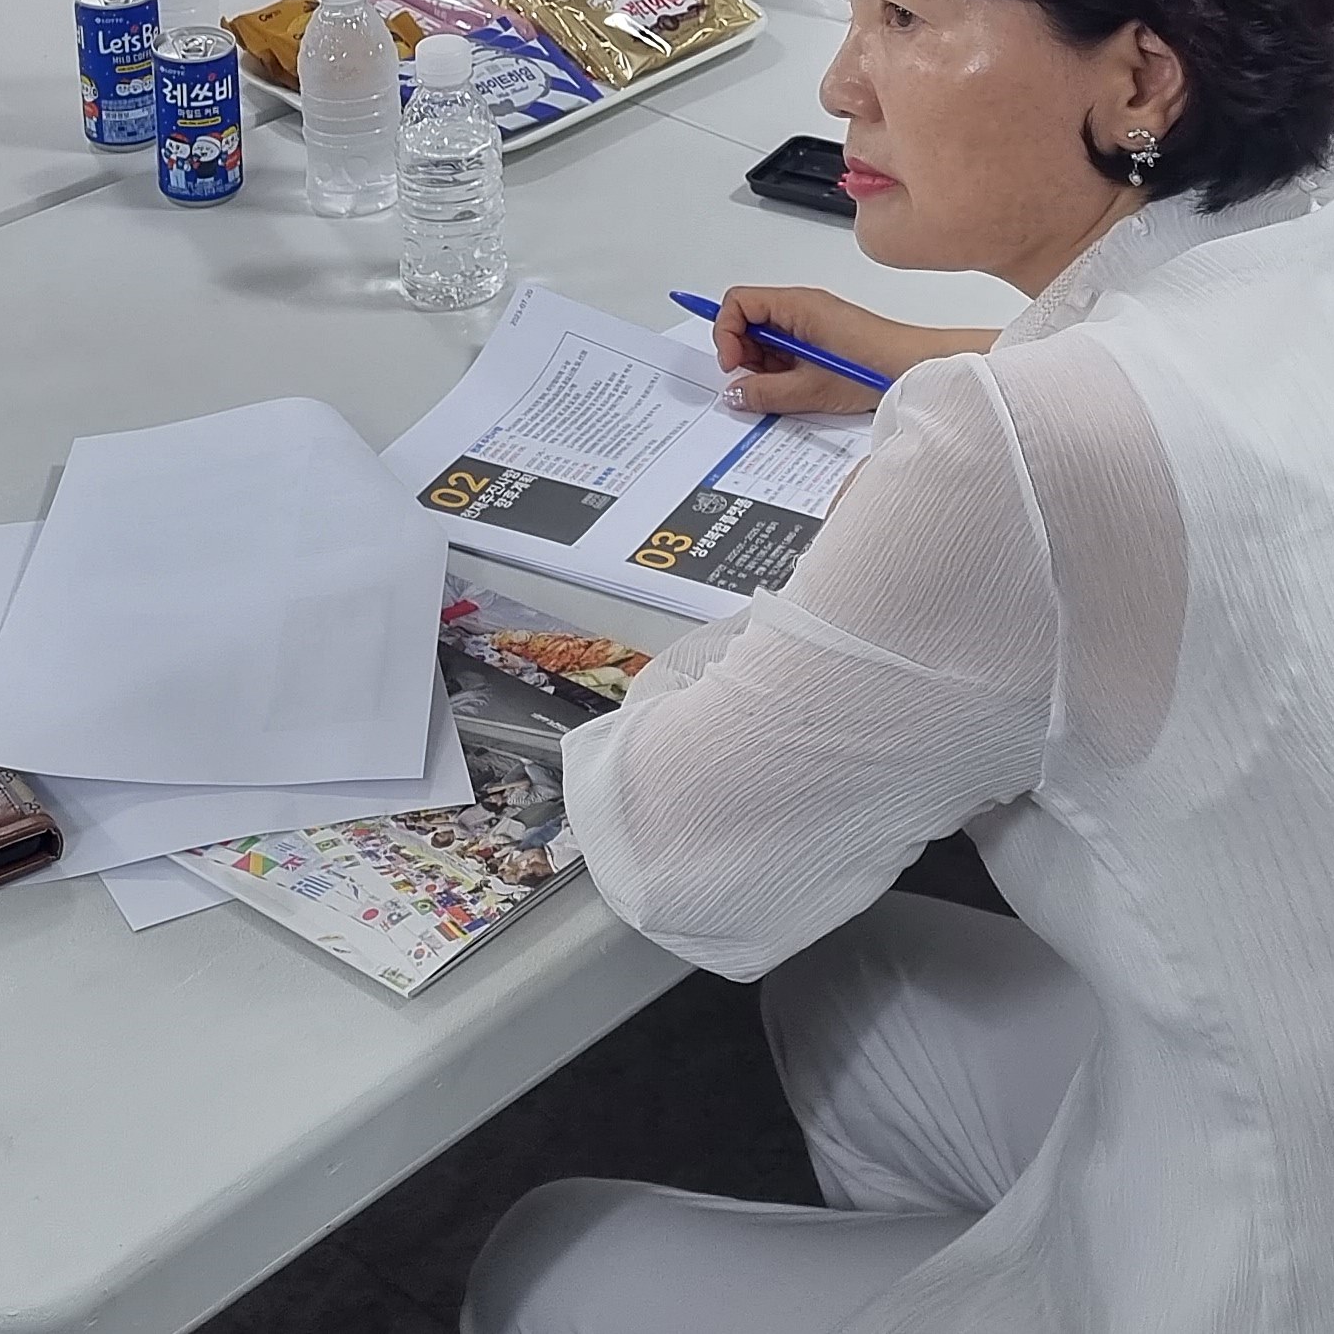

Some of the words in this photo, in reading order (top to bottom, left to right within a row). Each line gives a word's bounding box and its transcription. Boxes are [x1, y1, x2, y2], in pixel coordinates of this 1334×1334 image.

[162, 74, 233, 108] 레쓰비
[474, 65, 537, 95] 화이트하임
[177, 108, 202, 119] 마일드
[204, 106, 220, 117] 커피
[430, 472, 491, 508] 02
[689, 497, 754, 558] 상생복합플랫폼
[635, 531, 693, 569] 03
